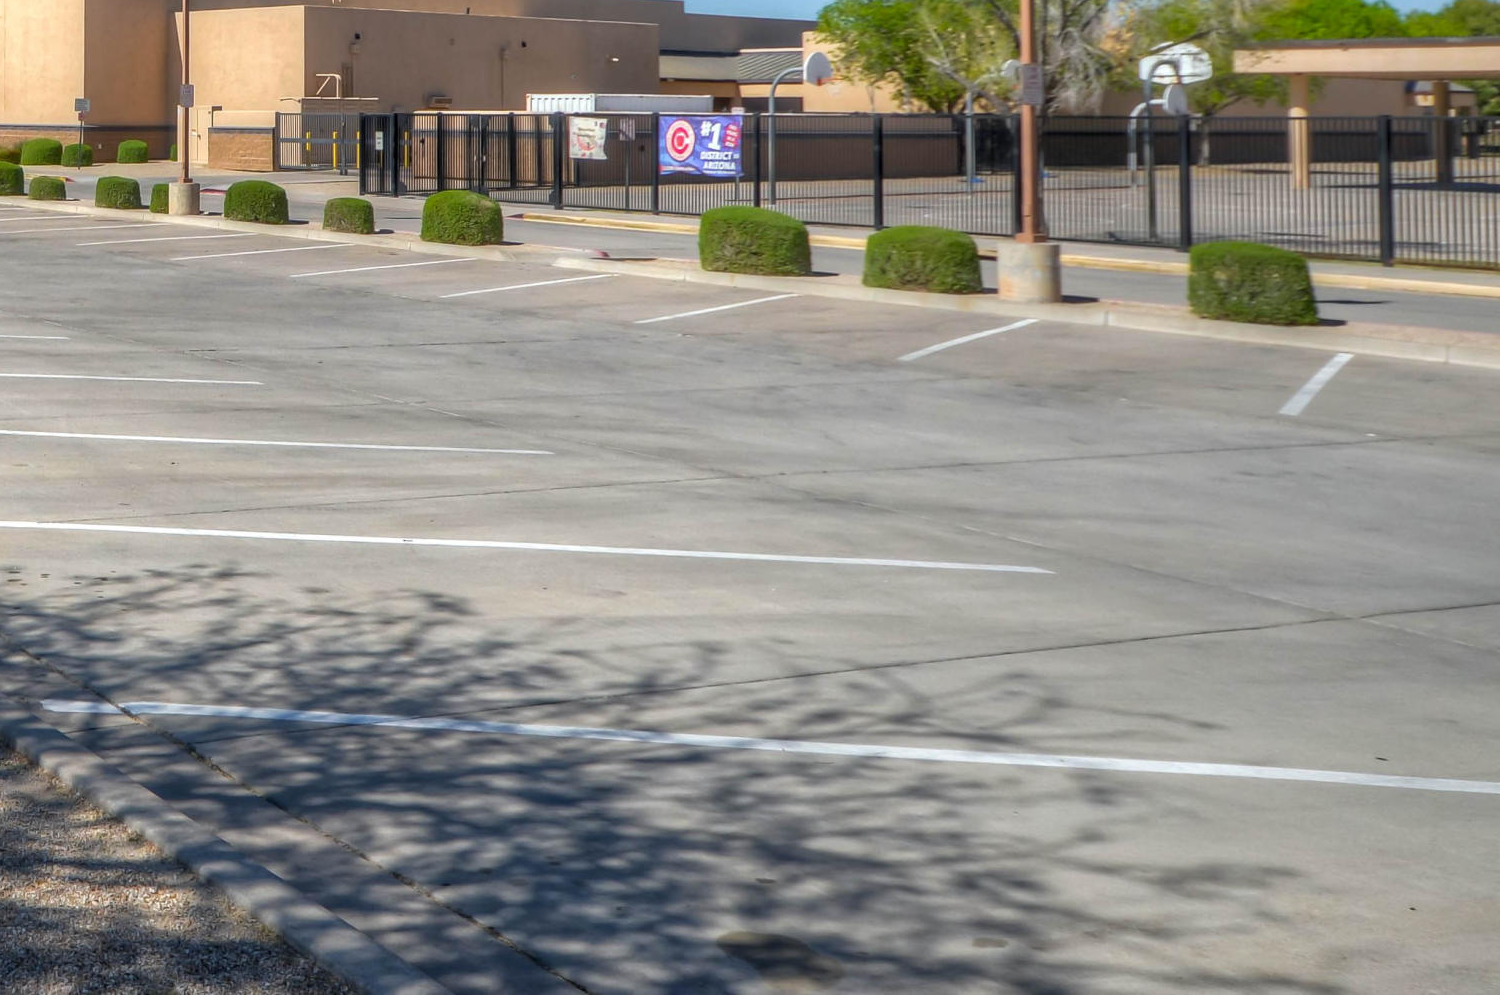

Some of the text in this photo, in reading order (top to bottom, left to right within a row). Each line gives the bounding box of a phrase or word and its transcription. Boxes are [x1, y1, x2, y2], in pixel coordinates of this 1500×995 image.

[700, 121, 721, 150] #1
[700, 151, 732, 160] DISTRICT
[703, 161, 735, 170] ARIZONA
